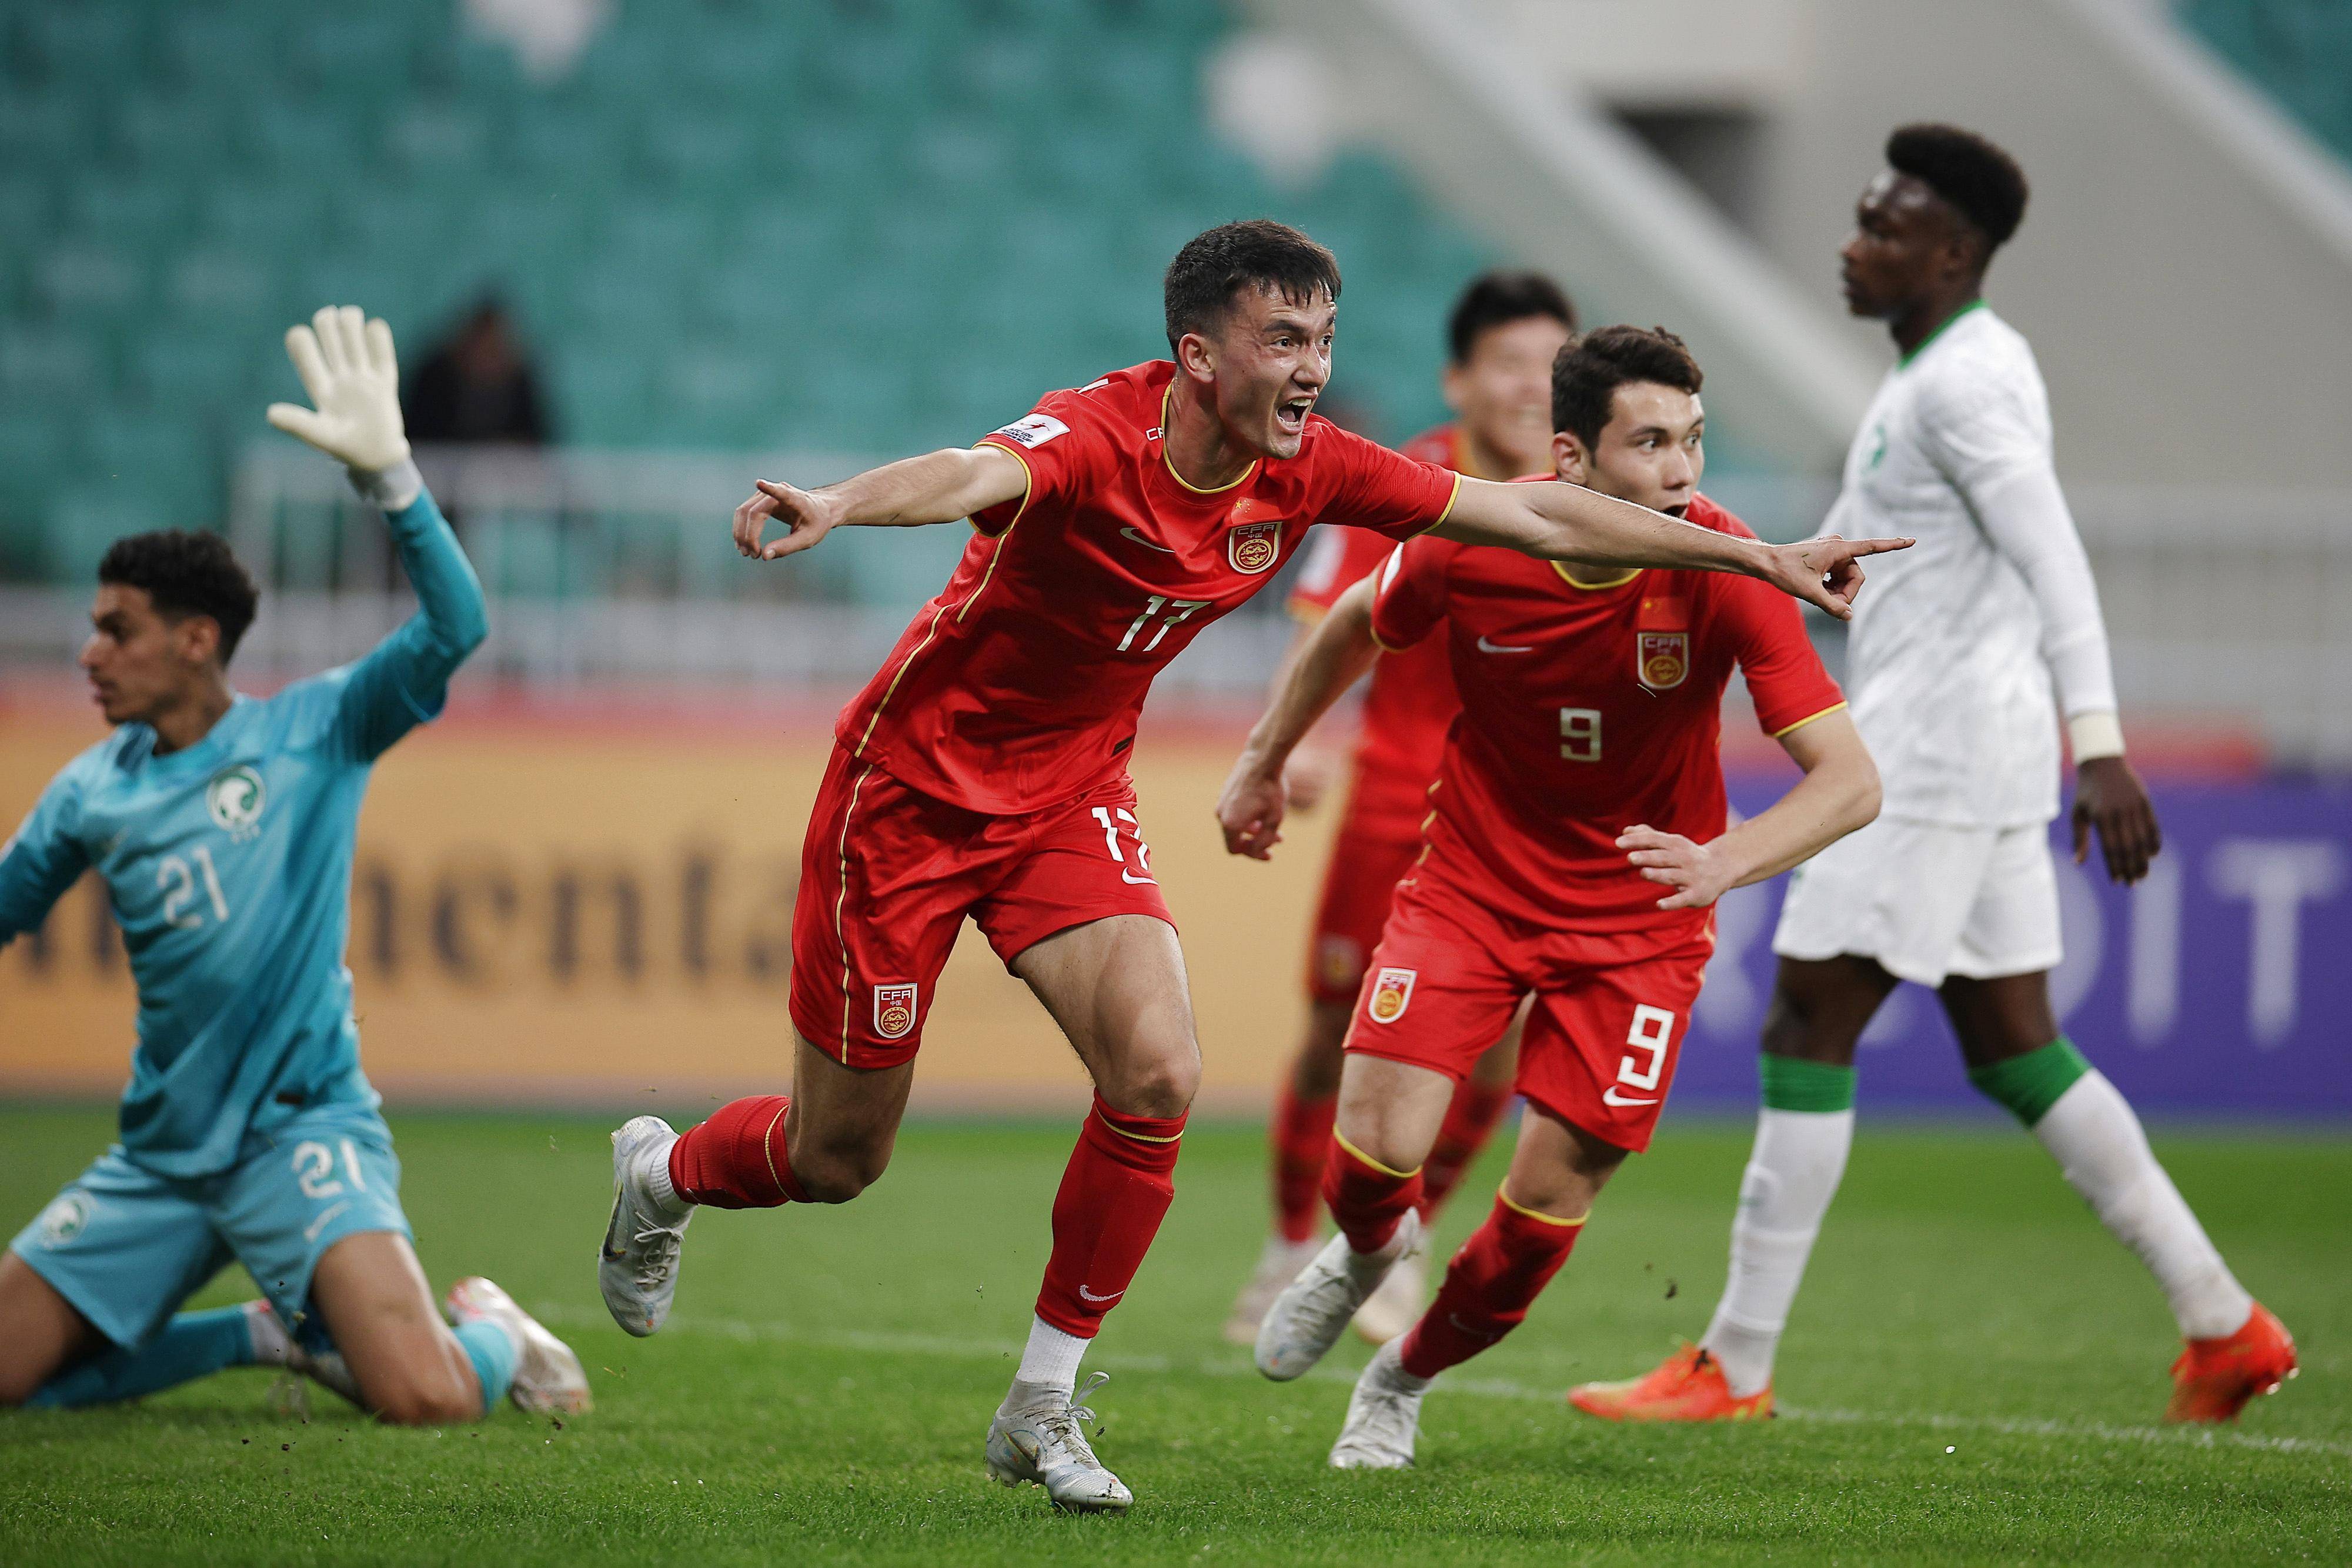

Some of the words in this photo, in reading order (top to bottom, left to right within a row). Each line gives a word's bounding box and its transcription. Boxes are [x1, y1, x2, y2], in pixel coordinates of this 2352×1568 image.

[1237, 524, 1275, 534] CFA
[1117, 595, 1211, 651] 17
[1559, 707, 1602, 762] 9
[1091, 806, 1148, 871] 17
[156, 845, 230, 929] 21
[881, 990, 911, 1001] CFA
[1617, 1003, 1675, 1091] 9
[292, 1139, 367, 1198] 21
